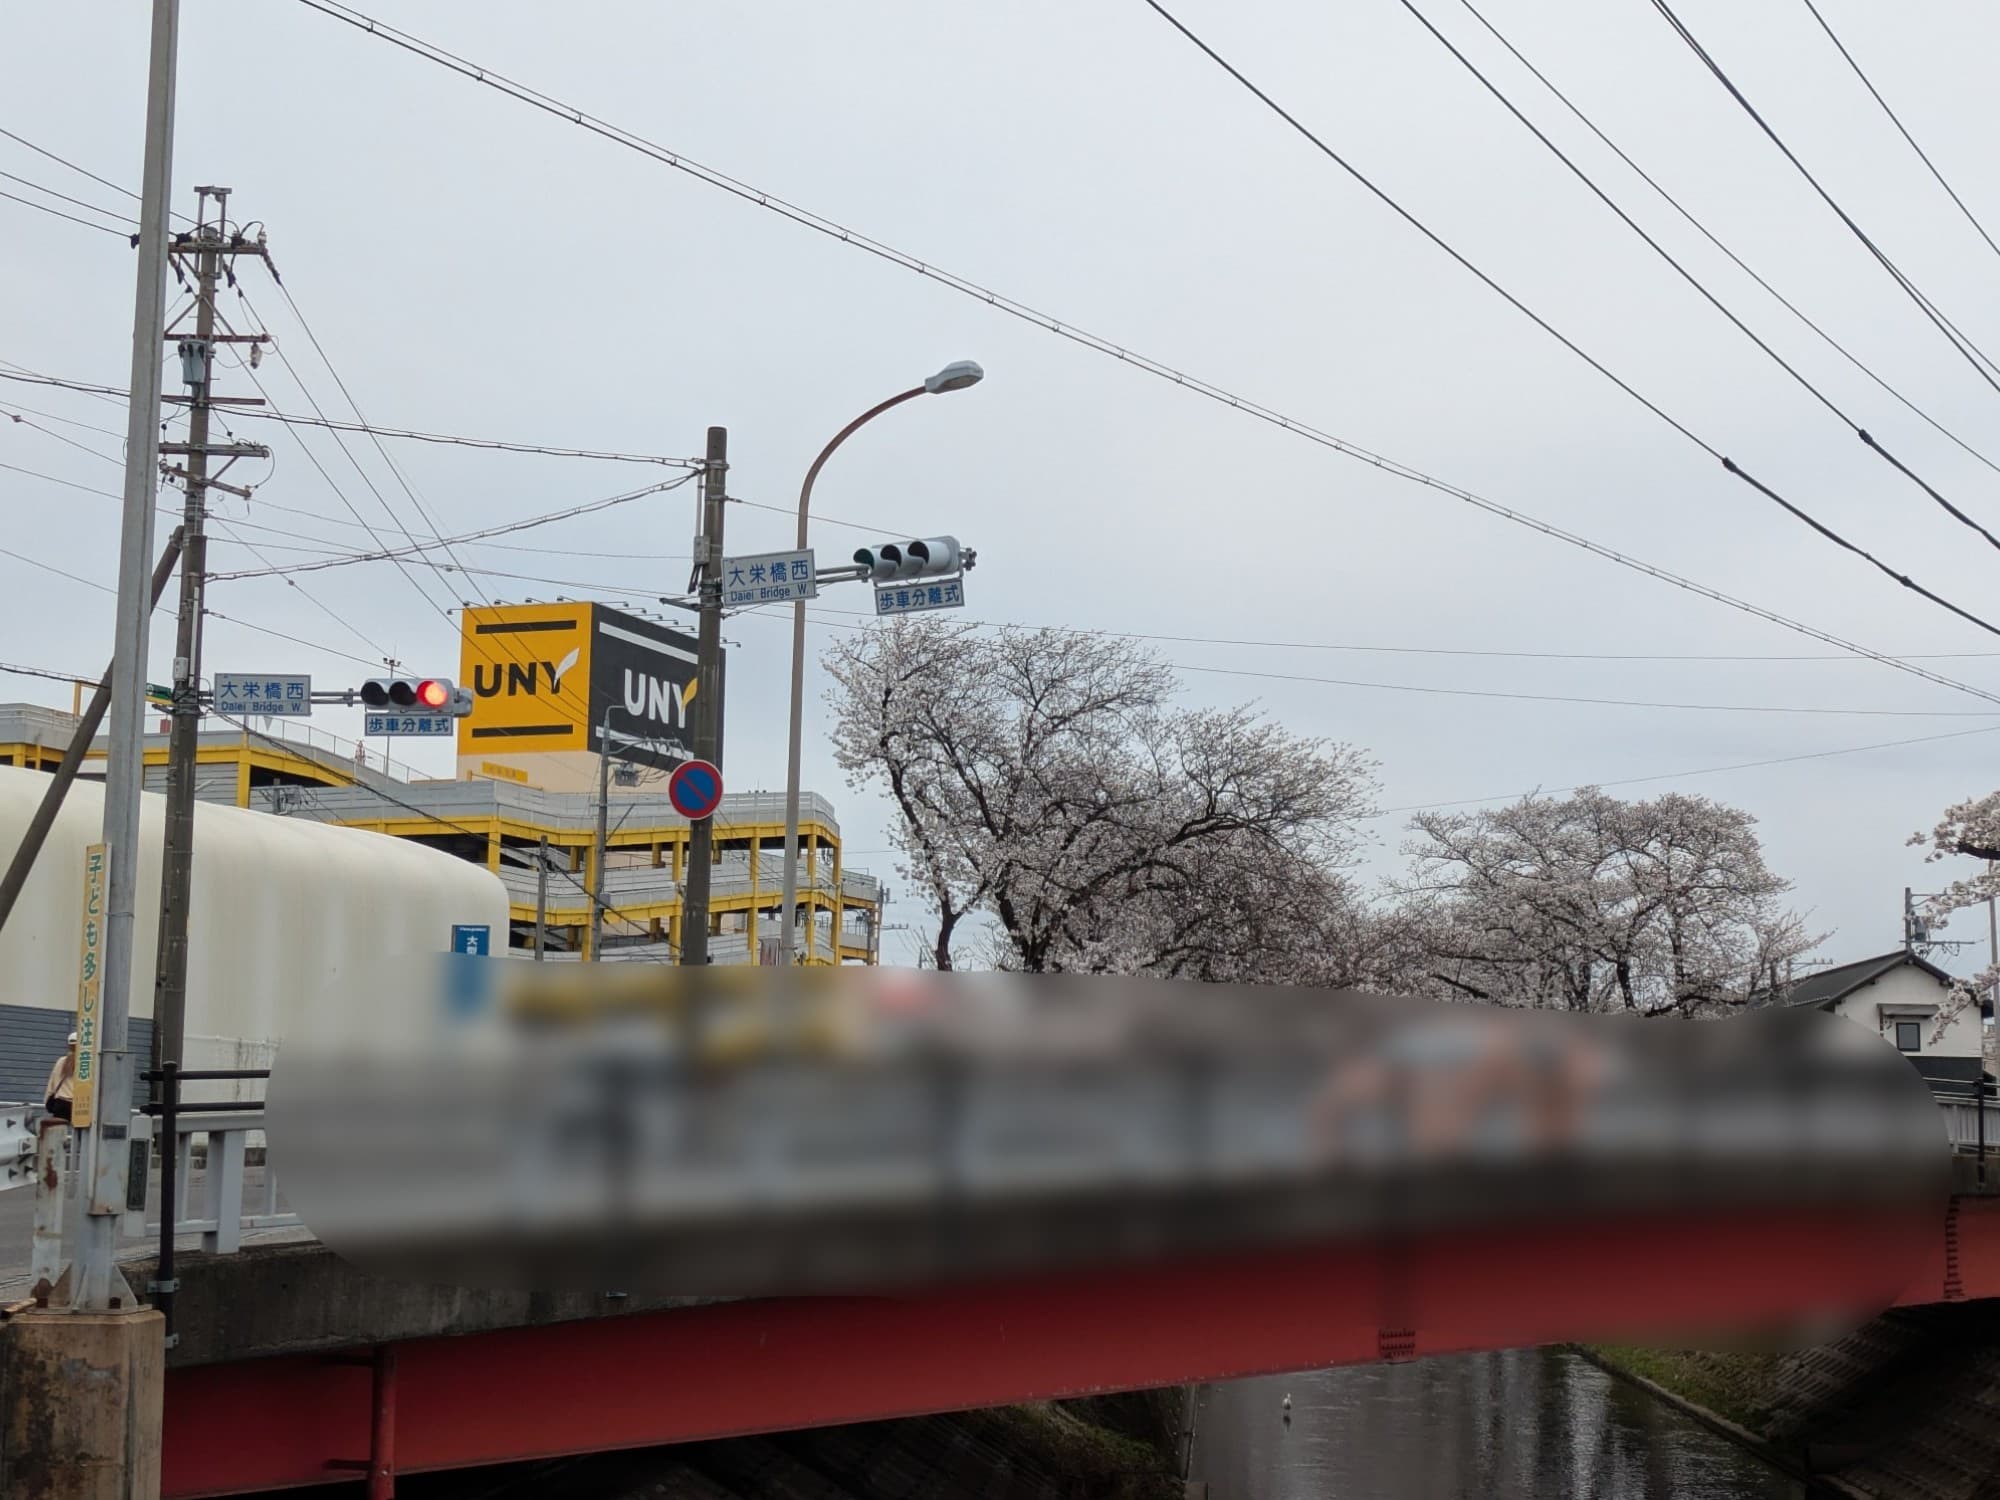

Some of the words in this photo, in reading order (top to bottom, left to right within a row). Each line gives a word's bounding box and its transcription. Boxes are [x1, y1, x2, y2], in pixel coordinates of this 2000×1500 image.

[728, 559, 809, 587] 大栄橋西
[730, 589, 754, 602] Daiei
[760, 587, 791, 600] Bridge
[879, 584, 961, 611] 歩車分離式
[474, 648, 579, 698] UNY
[220, 681, 305, 700] 大栄橋西
[624, 667, 697, 729] UNY
[221, 701, 246, 712] Daiei
[252, 701, 284, 714] Bridge
[368, 717, 449, 733] 歩車分離式
